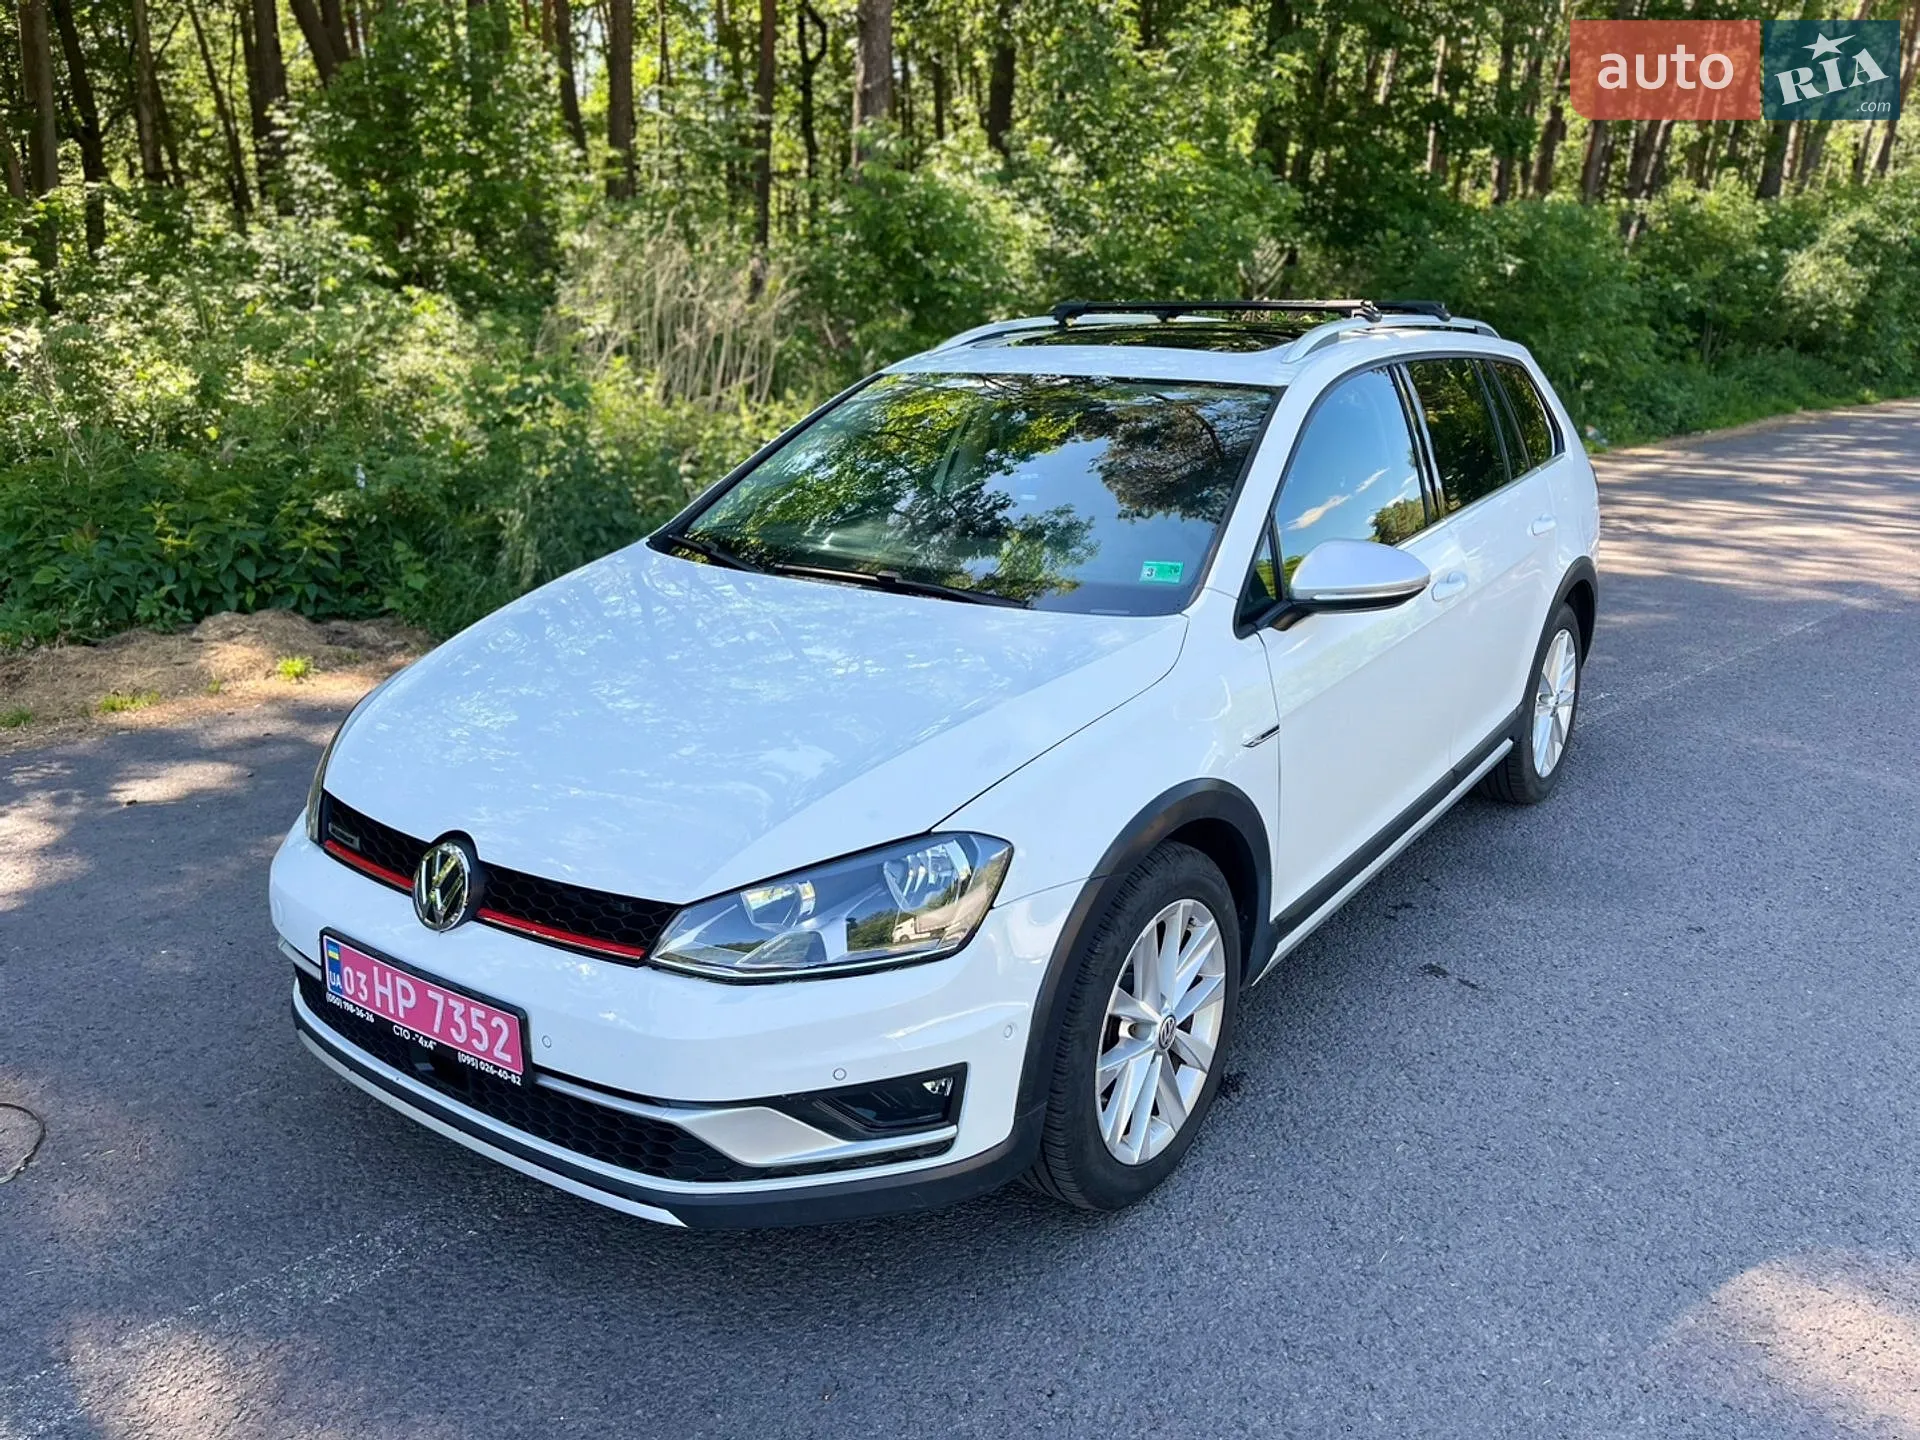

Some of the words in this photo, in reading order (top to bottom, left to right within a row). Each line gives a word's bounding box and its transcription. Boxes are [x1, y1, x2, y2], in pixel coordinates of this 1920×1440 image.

[329, 971, 342, 989] UA
[343, 966, 368, 1003] 03
[373, 966, 416, 1019] HP
[426, 989, 512, 1063] 7352
